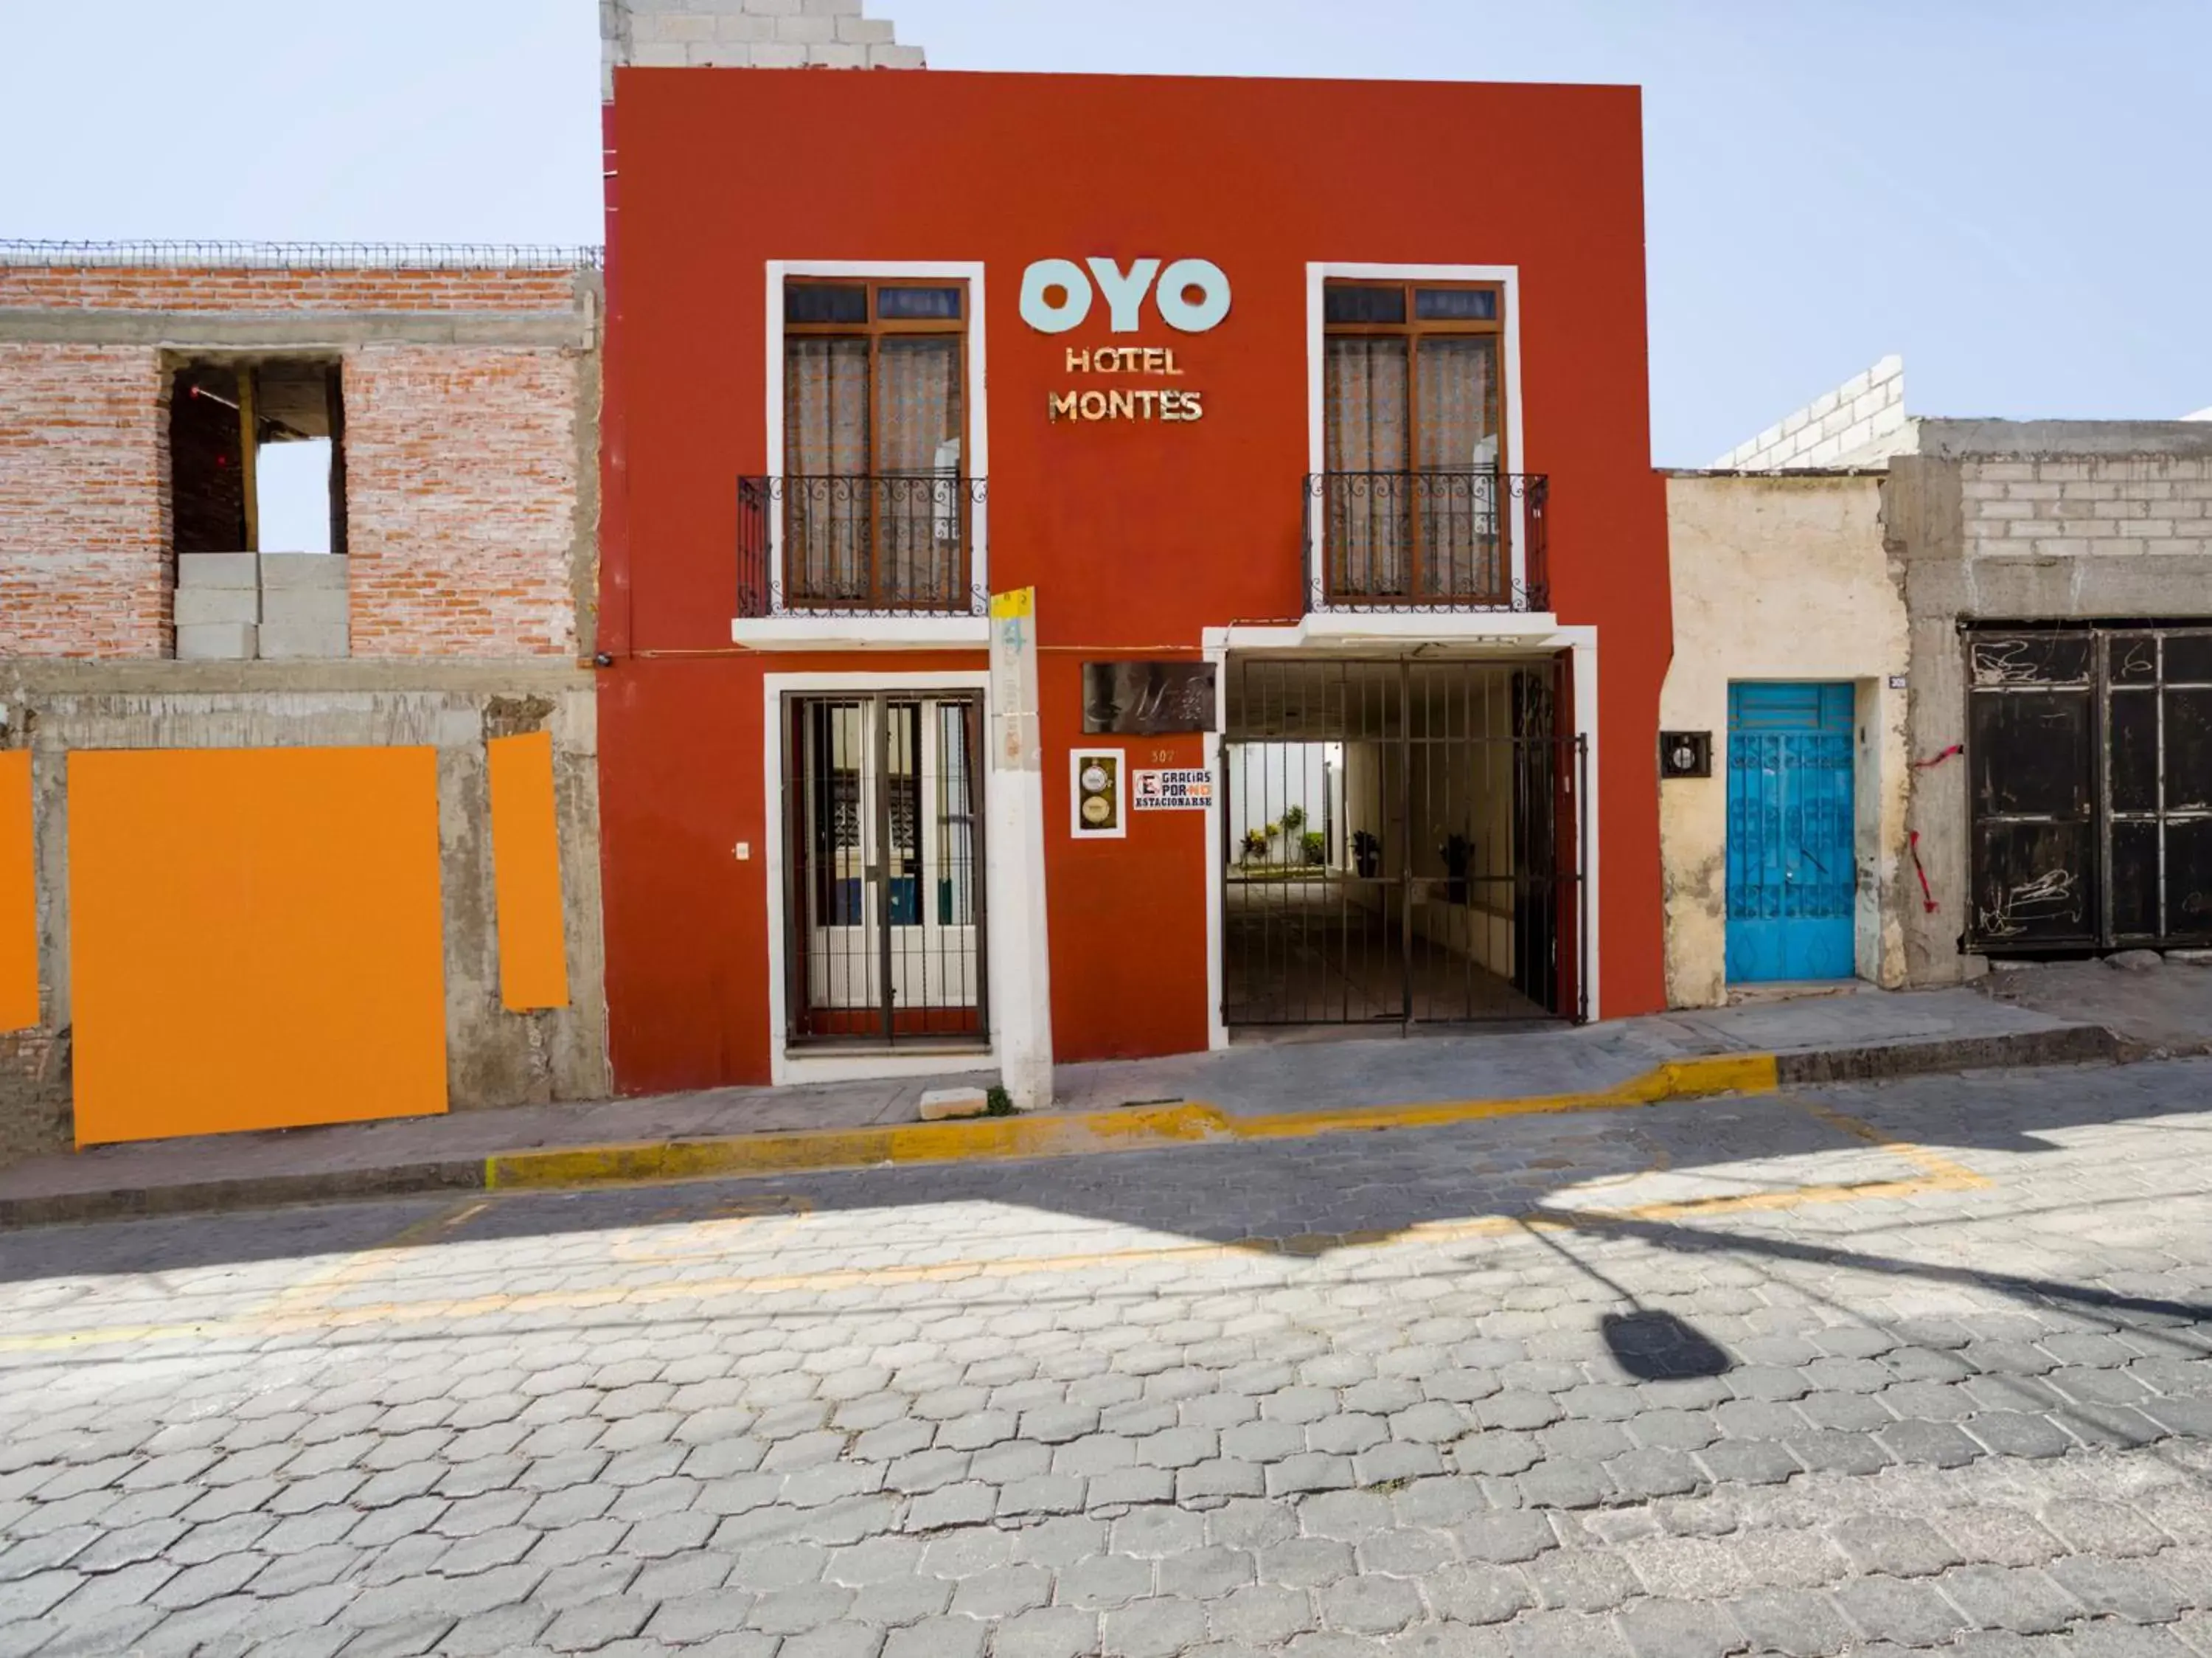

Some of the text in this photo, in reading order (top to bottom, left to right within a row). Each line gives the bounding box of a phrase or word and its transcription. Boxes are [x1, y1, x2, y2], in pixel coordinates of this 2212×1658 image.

[1019, 257, 1232, 333] OYO
[1065, 347, 1184, 375] HOTEL
[1048, 389, 1203, 423] MONTES
[1162, 771, 1211, 783] GRACIAS
[1162, 784, 1186, 796] POR
[1135, 797, 1212, 807] ESTACIONARSE
